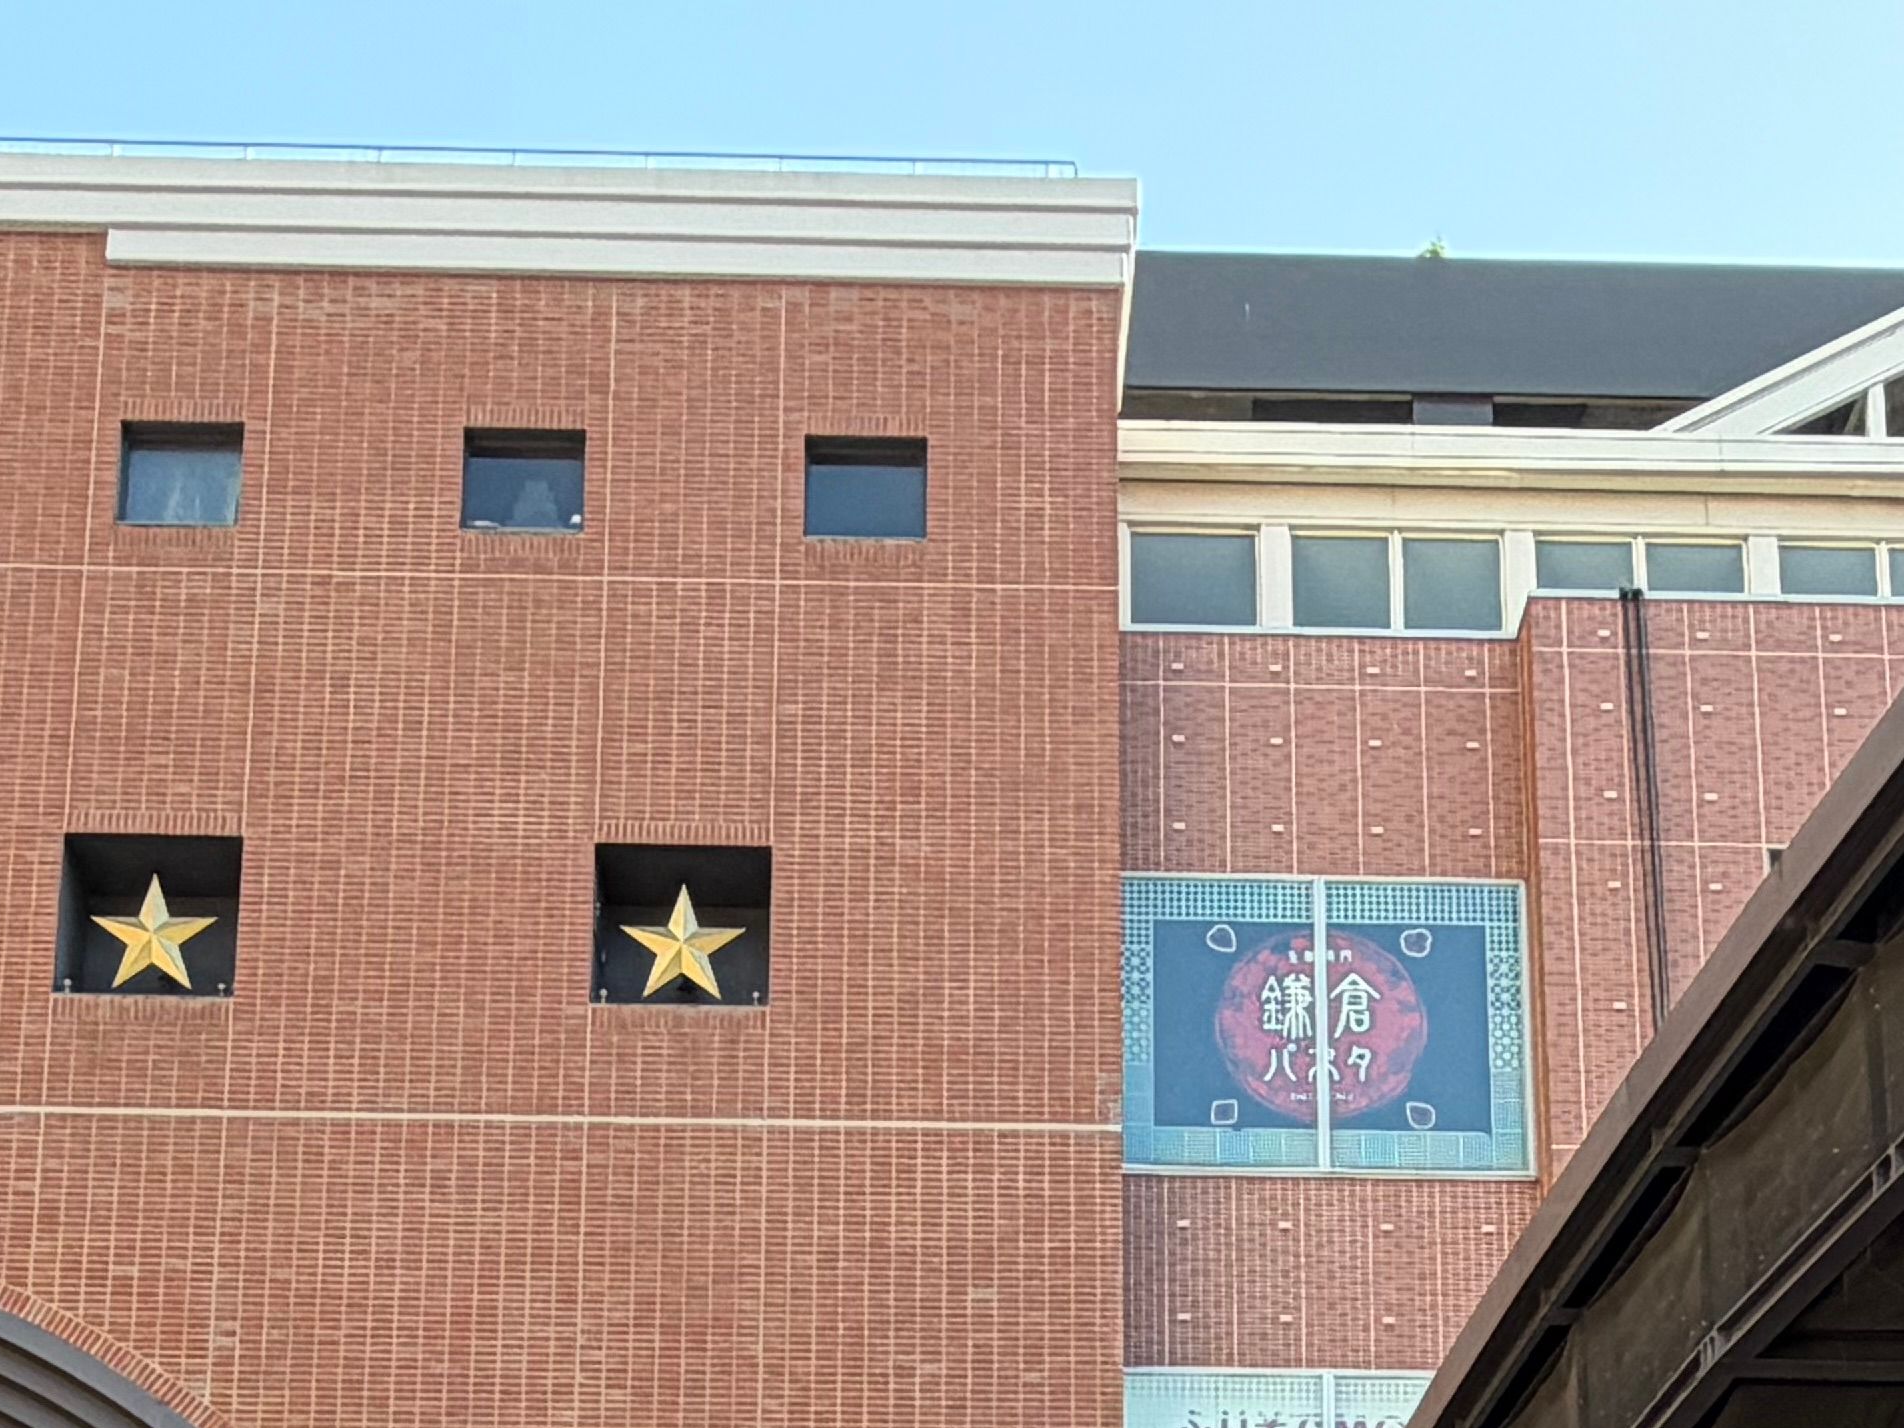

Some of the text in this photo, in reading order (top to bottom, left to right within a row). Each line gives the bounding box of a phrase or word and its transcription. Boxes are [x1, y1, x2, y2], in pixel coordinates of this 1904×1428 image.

[1261, 972, 1382, 1040] 鎌倉
[1263, 1043, 1373, 1083] パスタ
